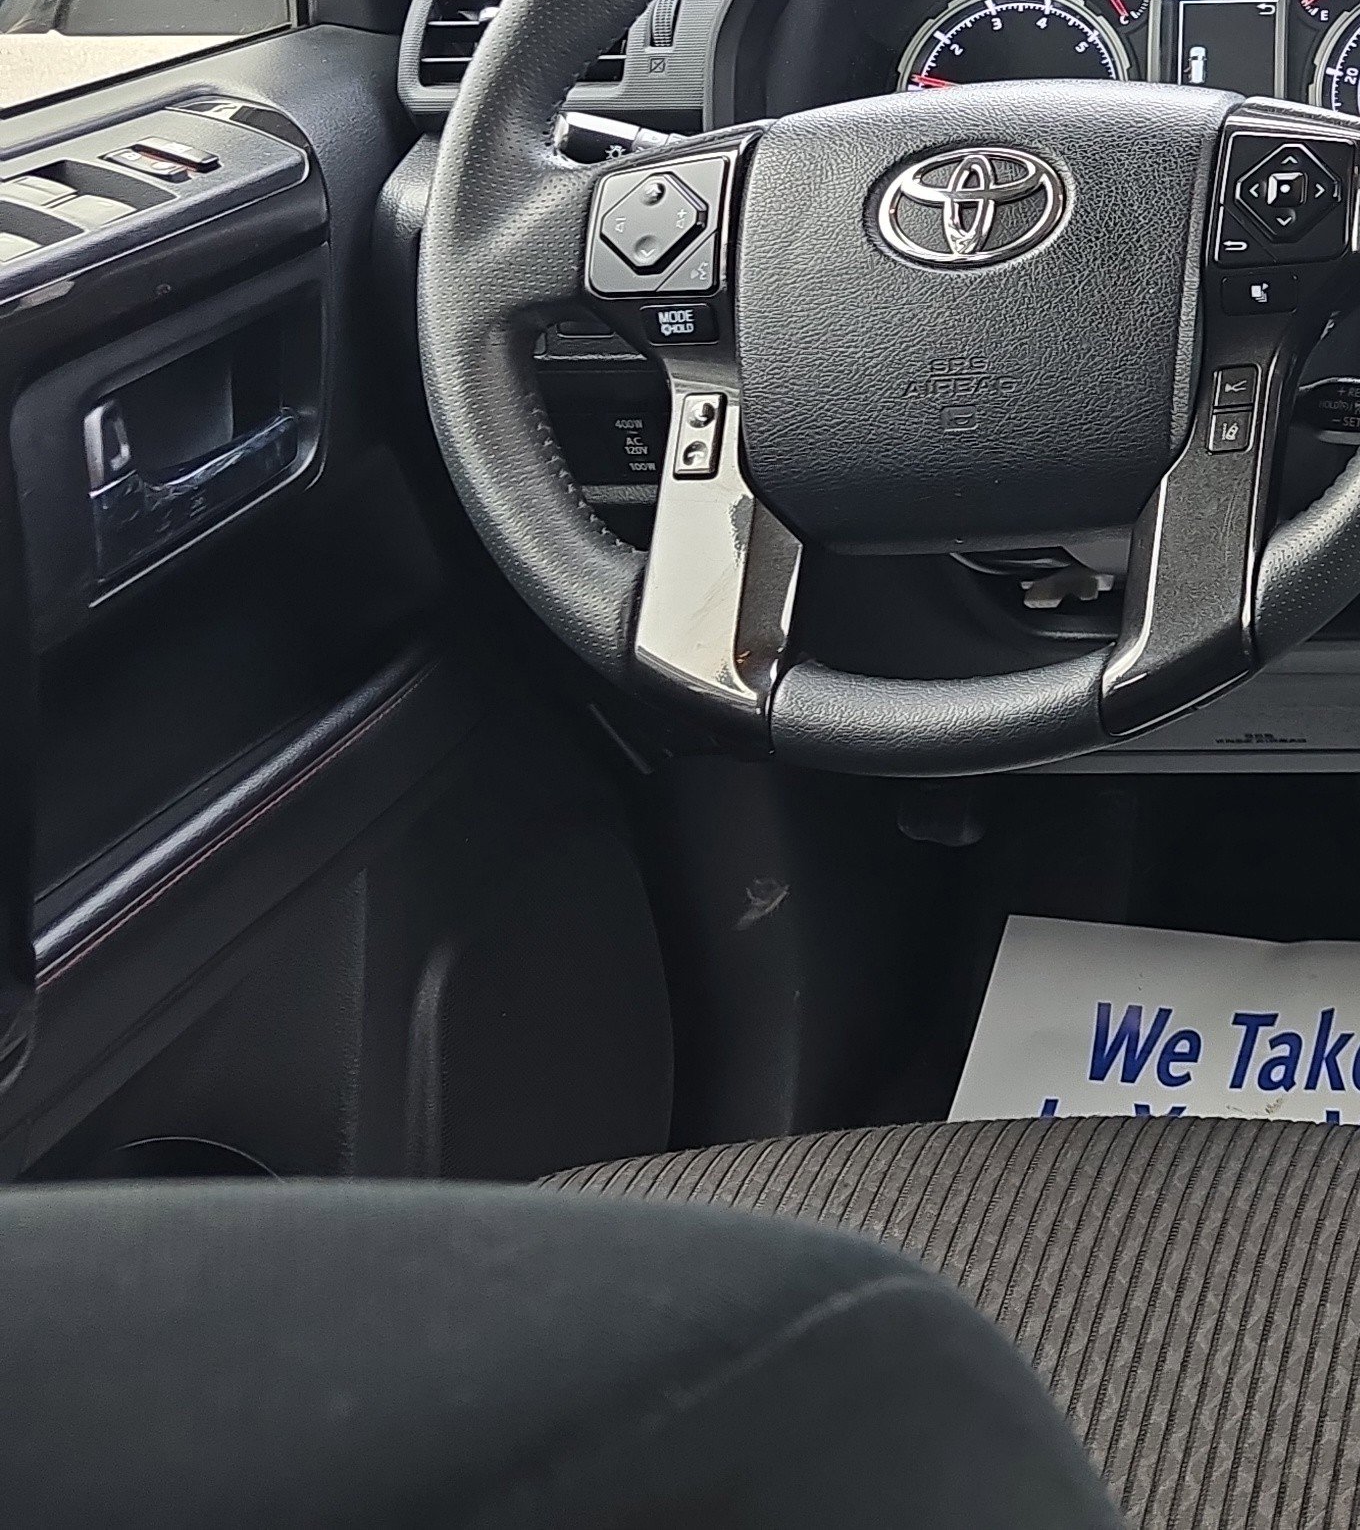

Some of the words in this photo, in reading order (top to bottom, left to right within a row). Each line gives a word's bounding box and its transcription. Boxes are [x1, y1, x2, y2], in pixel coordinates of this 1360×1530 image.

[1320, 10, 1329, 20] E
[991, 18, 1002, 30] 3
[1036, 17, 1047, 29] 4
[950, 43, 963, 56] 2
[1075, 42, 1089, 53] 5
[1345, 67, 1359, 85] 20
[658, 310, 694, 324] MODE
[671, 323, 694, 333] HOLD
[615, 419, 643, 429] 400W
[626, 437, 643, 446] AC
[624, 446, 648, 455] 120V
[629, 462, 656, 471] 100W
[1088, 1001, 1202, 1086] We
